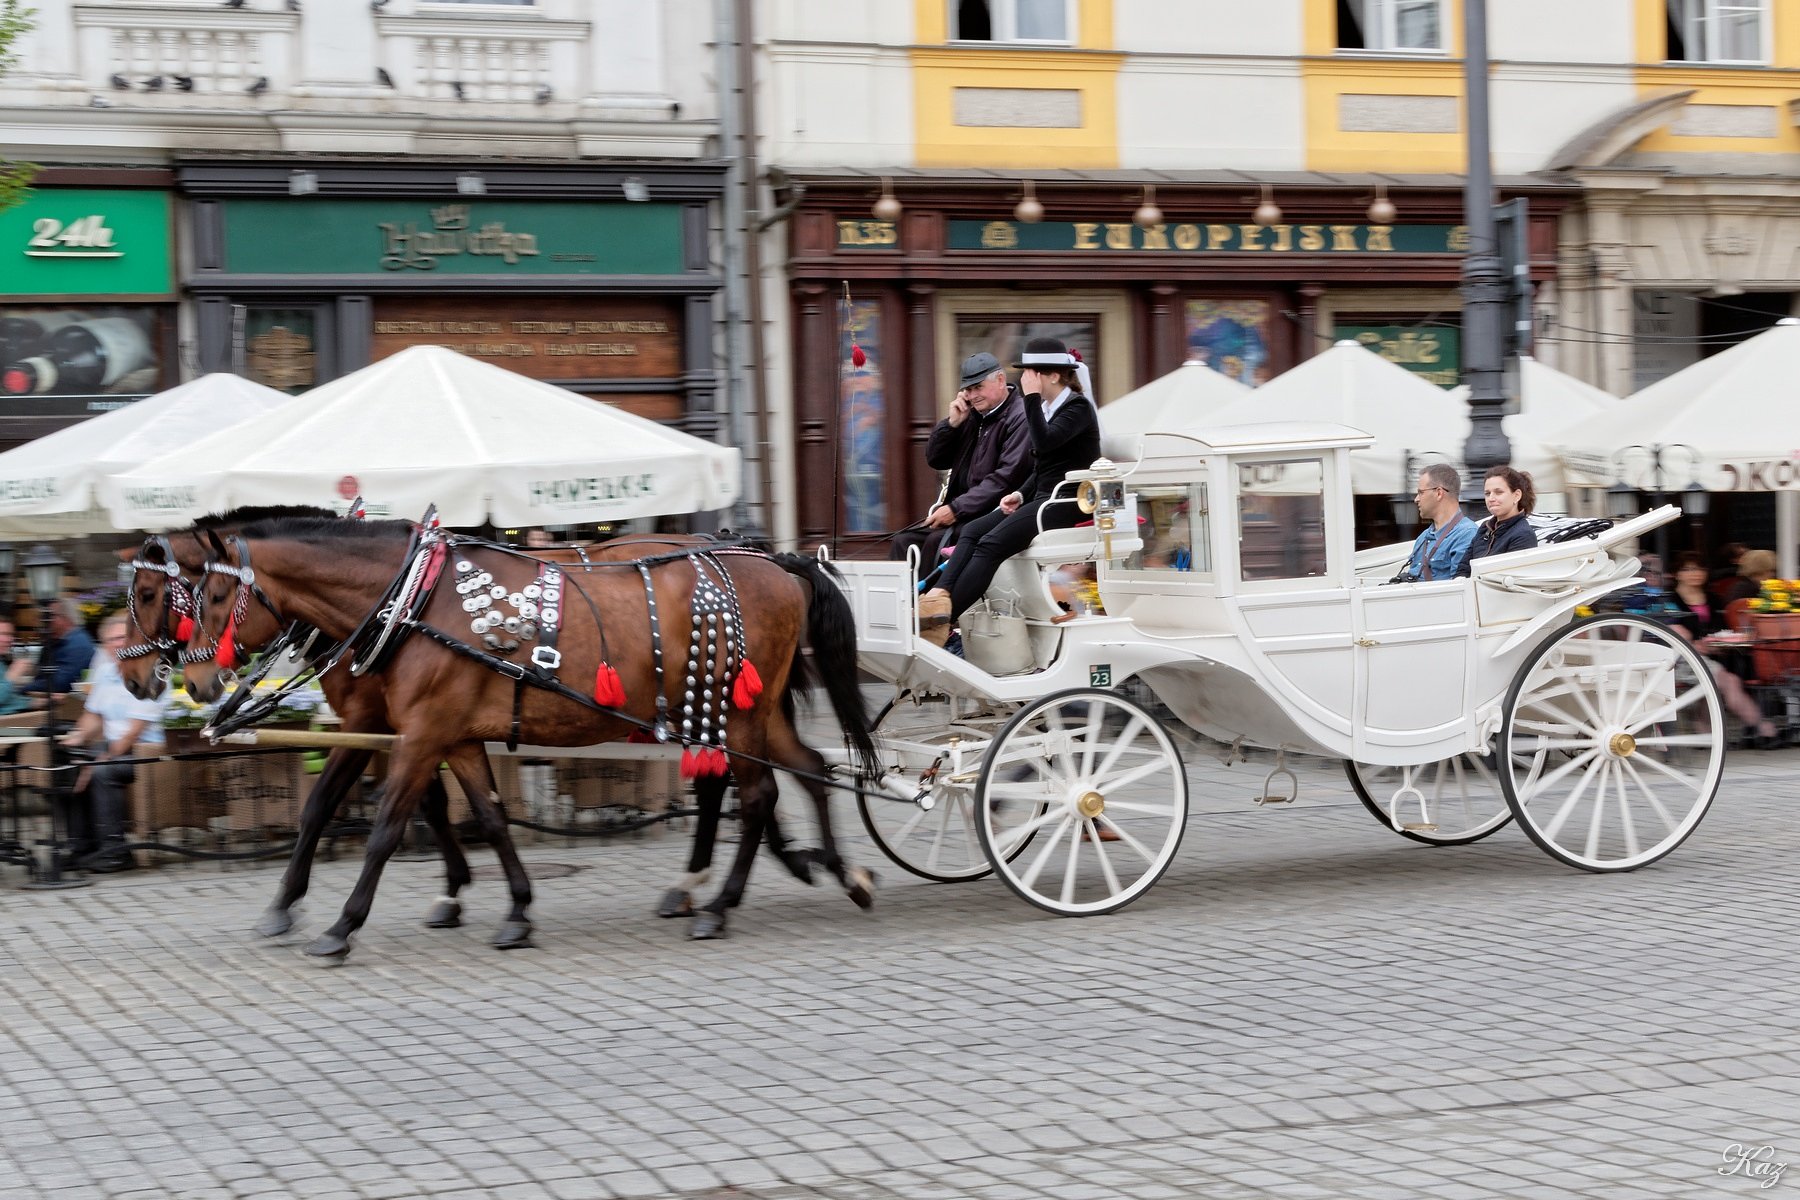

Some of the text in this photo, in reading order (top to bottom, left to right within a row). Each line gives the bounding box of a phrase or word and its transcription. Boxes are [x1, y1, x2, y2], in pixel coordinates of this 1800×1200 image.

[27, 214, 118, 248] 24h
[1072, 222, 1395, 251] EUROPEJSKA
[1092, 672, 1110, 686] 23
